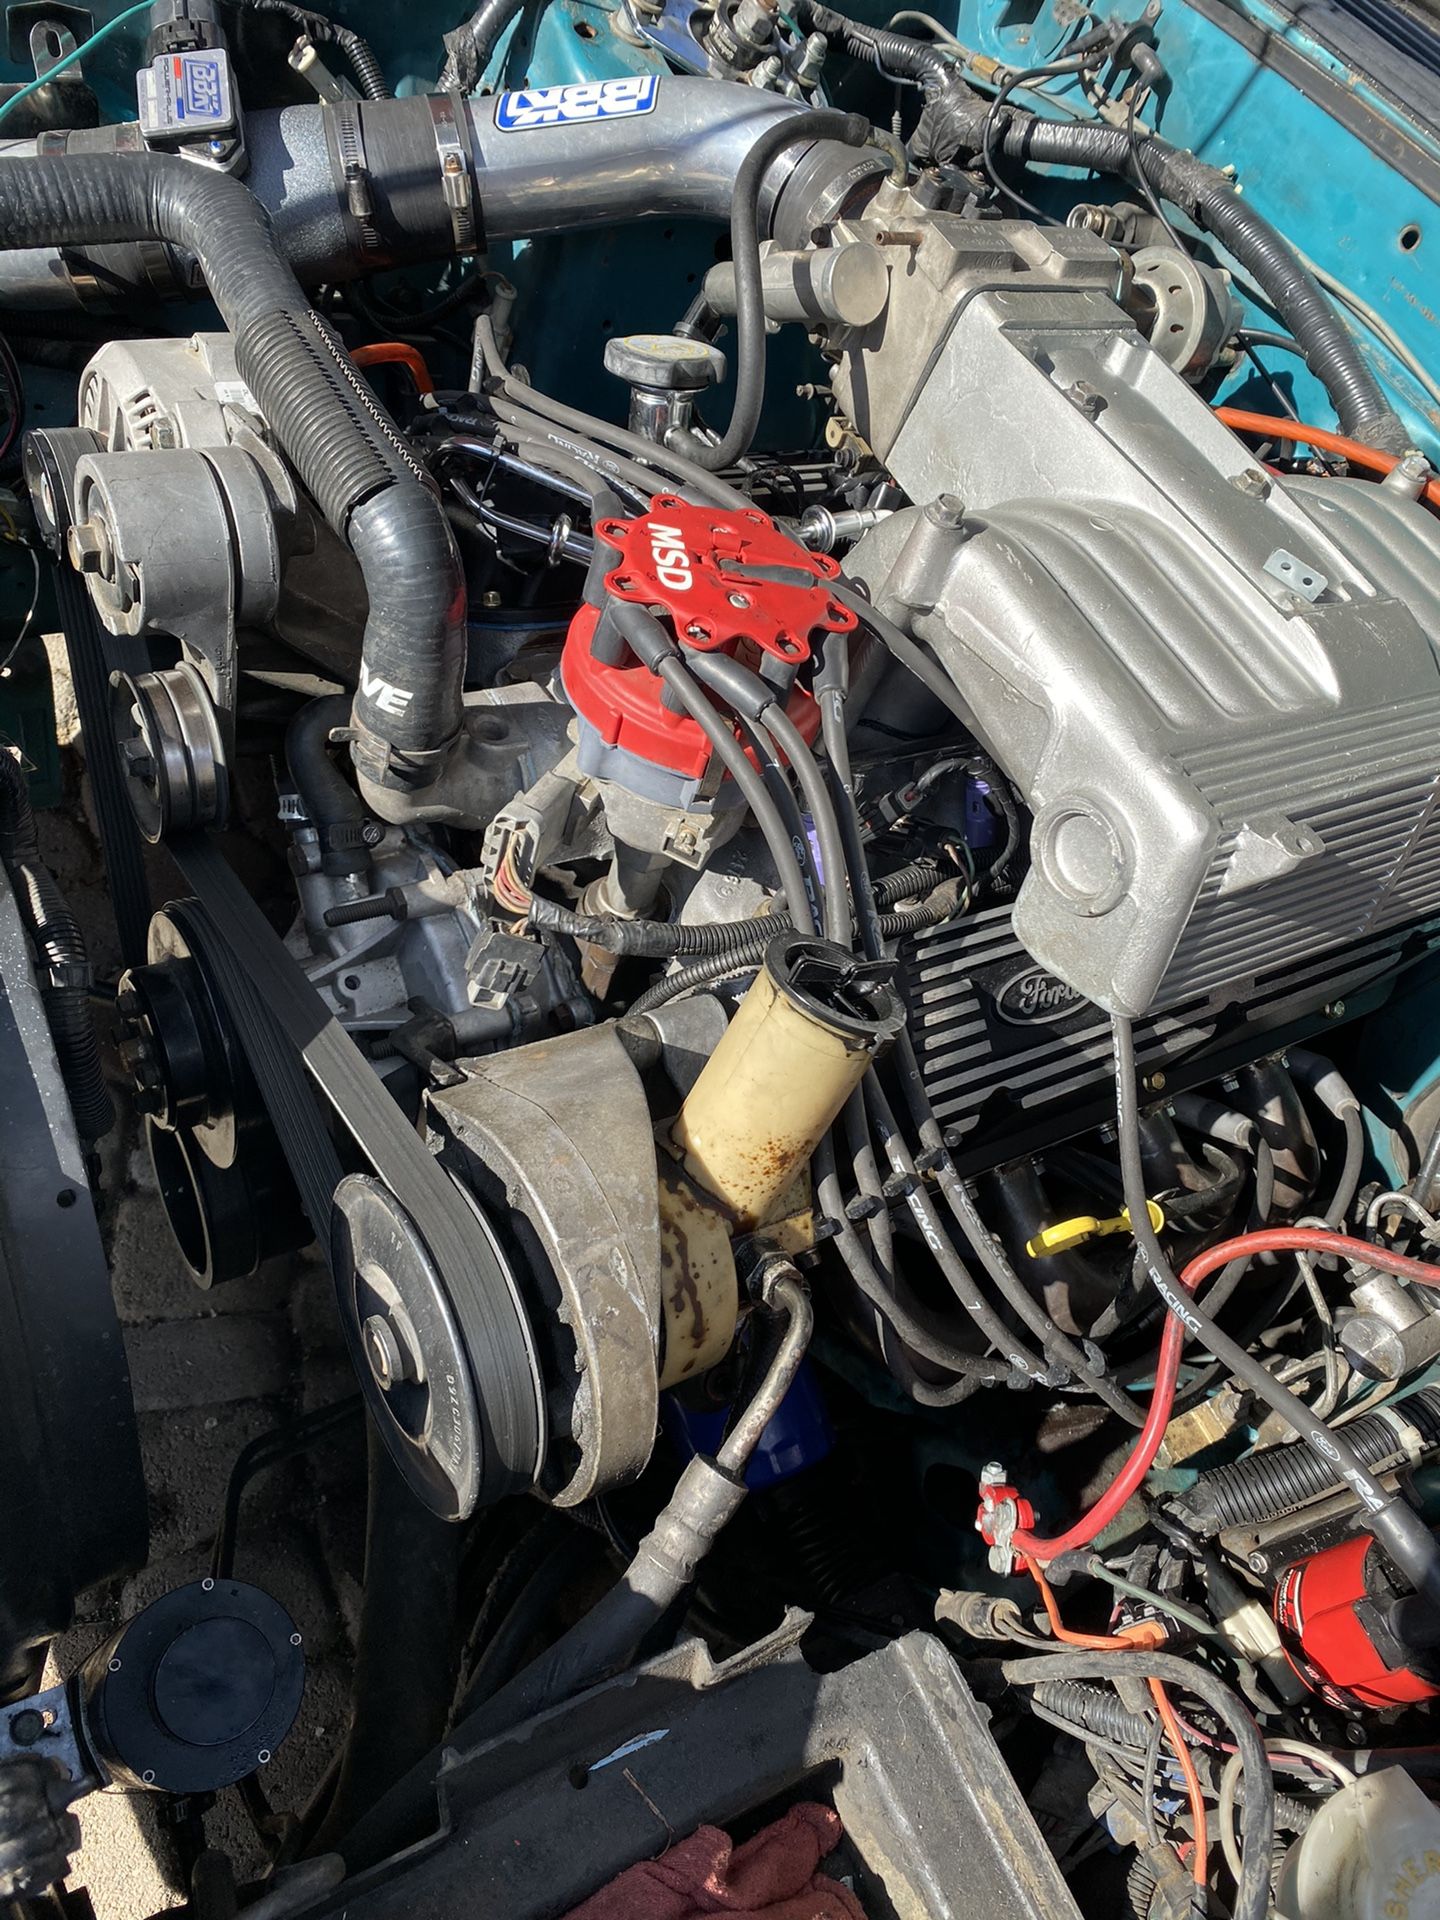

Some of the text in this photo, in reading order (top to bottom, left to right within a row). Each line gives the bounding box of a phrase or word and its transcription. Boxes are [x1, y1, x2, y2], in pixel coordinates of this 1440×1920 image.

[191, 63, 218, 111] BBK
[506, 77, 652, 126] BBK
[647, 522, 693, 591] MSD
[1148, 1265, 1203, 1334] RACING
